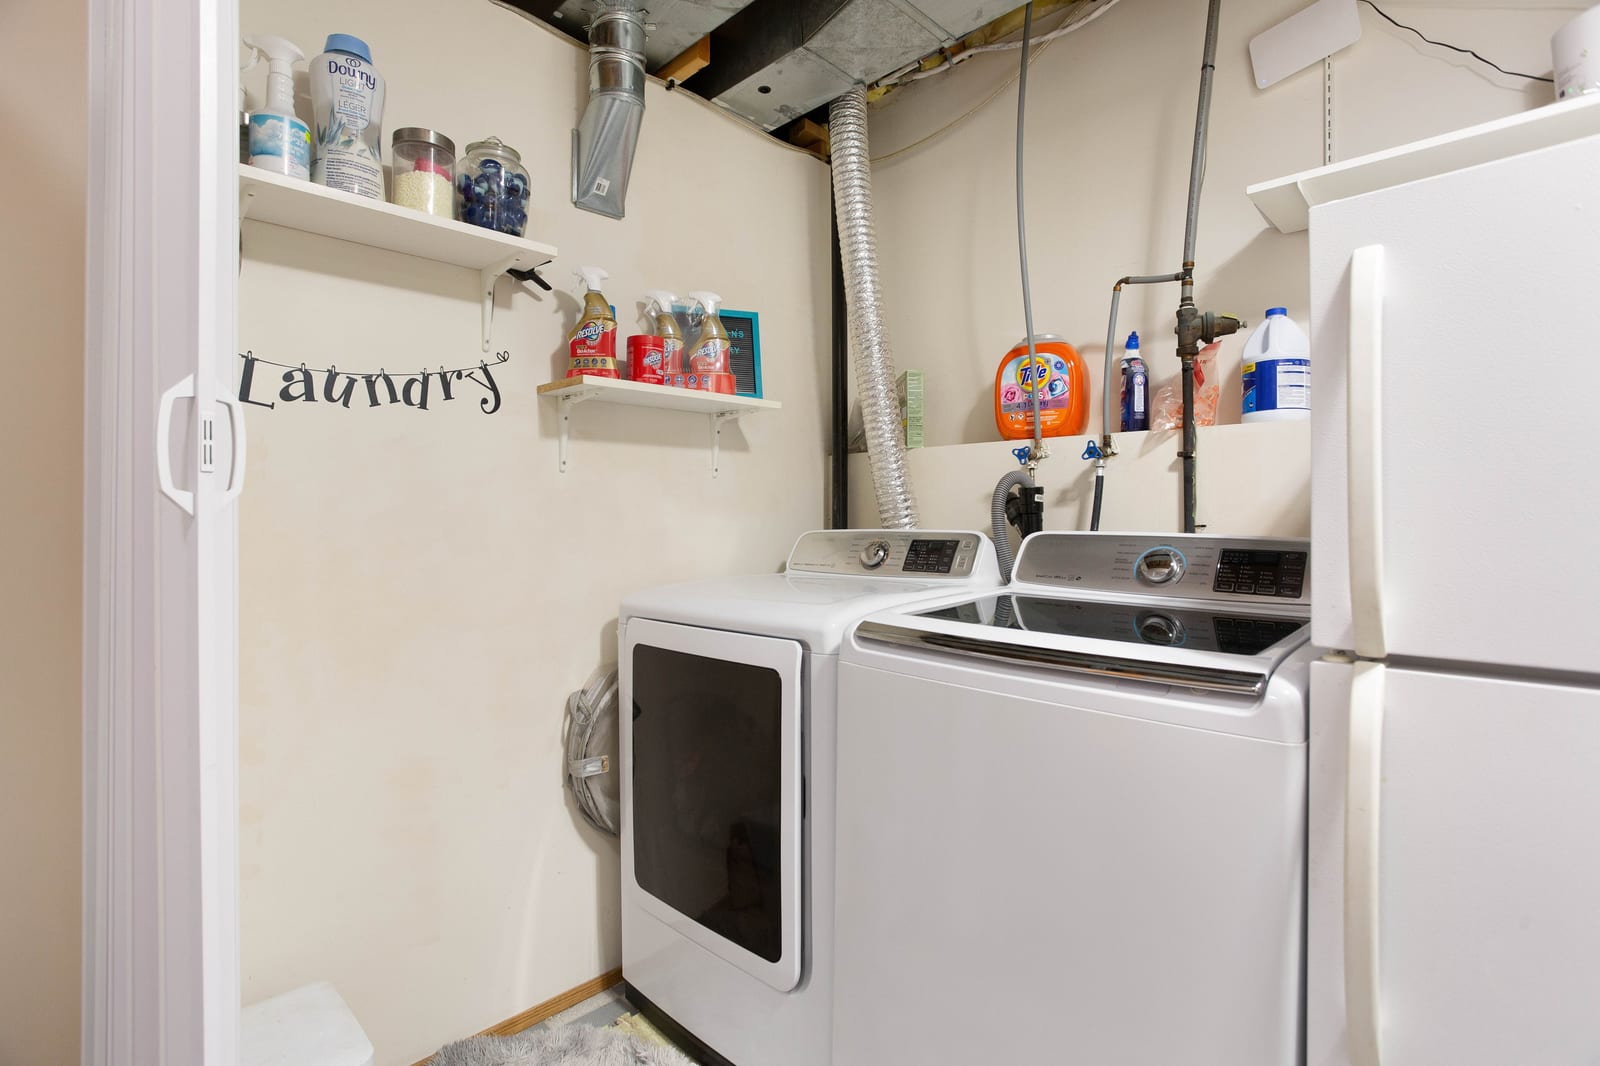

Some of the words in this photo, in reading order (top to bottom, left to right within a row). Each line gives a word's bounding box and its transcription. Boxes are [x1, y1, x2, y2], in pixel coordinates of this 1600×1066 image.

[576, 324, 605, 341] RESOLVE
[238, 356, 501, 414] Laundry
[1023, 391, 1044, 400] POS
